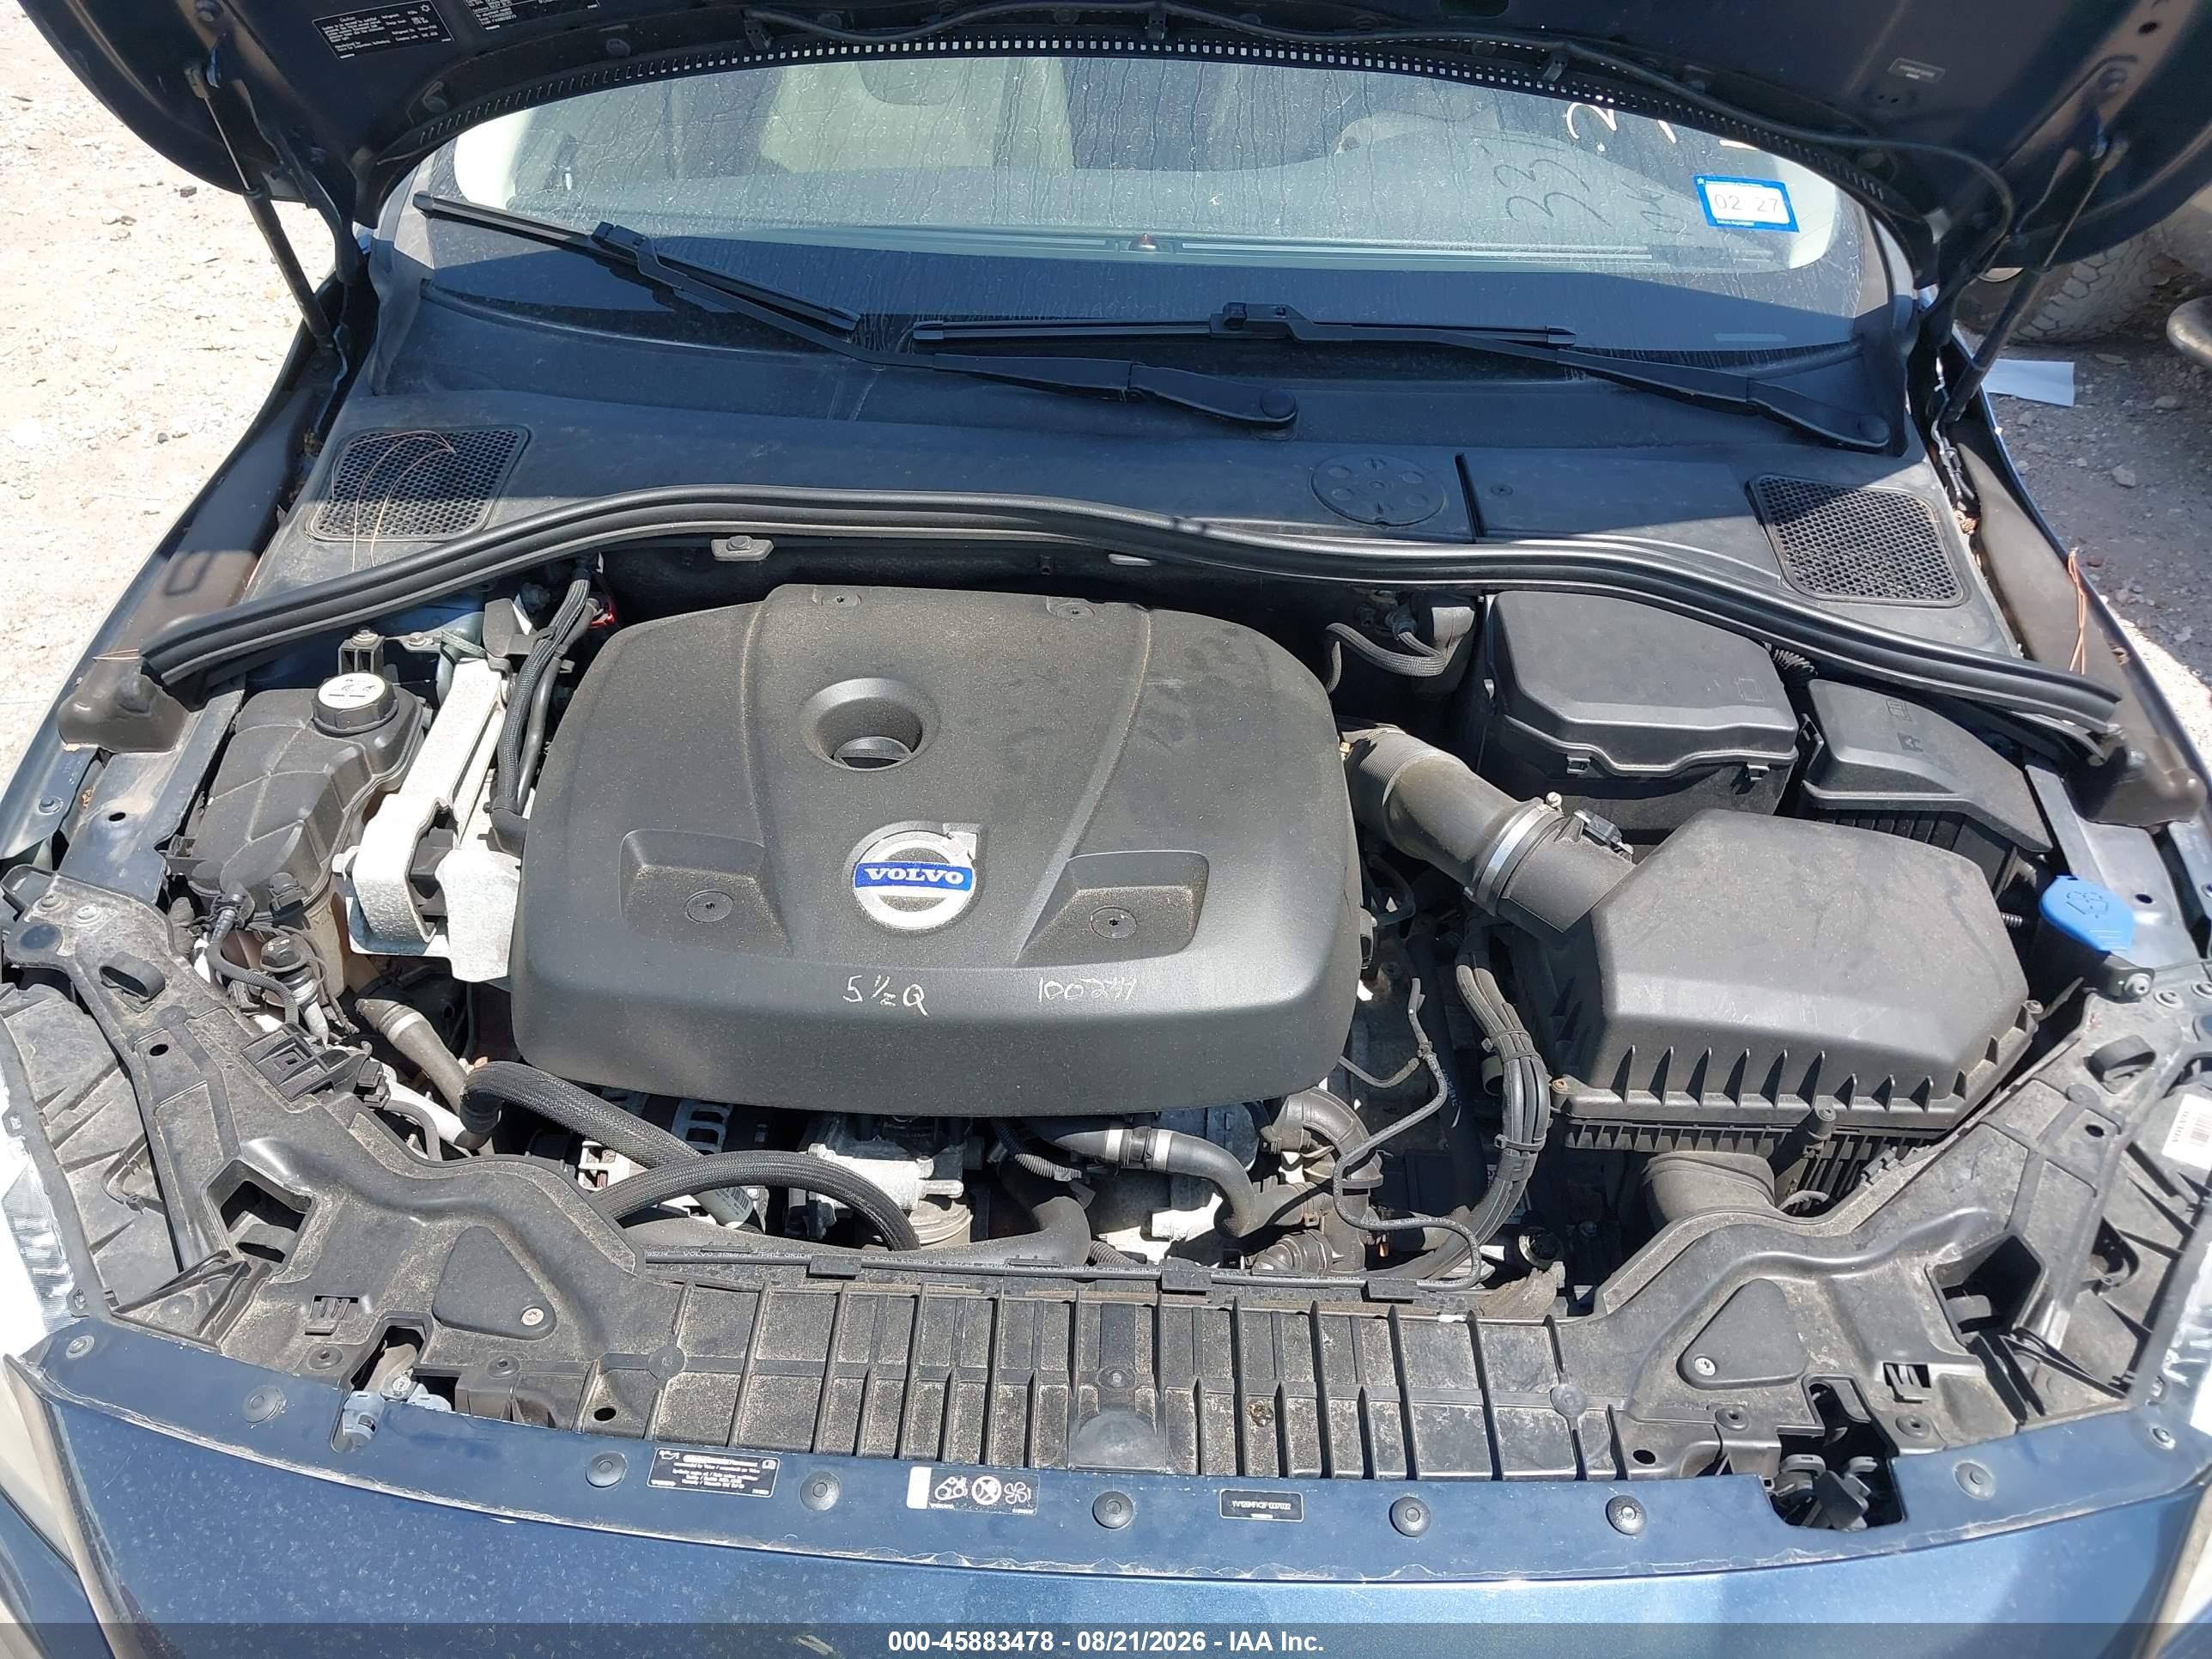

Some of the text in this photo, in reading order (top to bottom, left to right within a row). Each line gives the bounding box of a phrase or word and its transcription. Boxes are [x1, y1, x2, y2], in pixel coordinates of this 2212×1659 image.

[1714, 194, 1742, 210] 02
[865, 868, 964, 884] VOLVO
[842, 975, 863, 1003] 5
